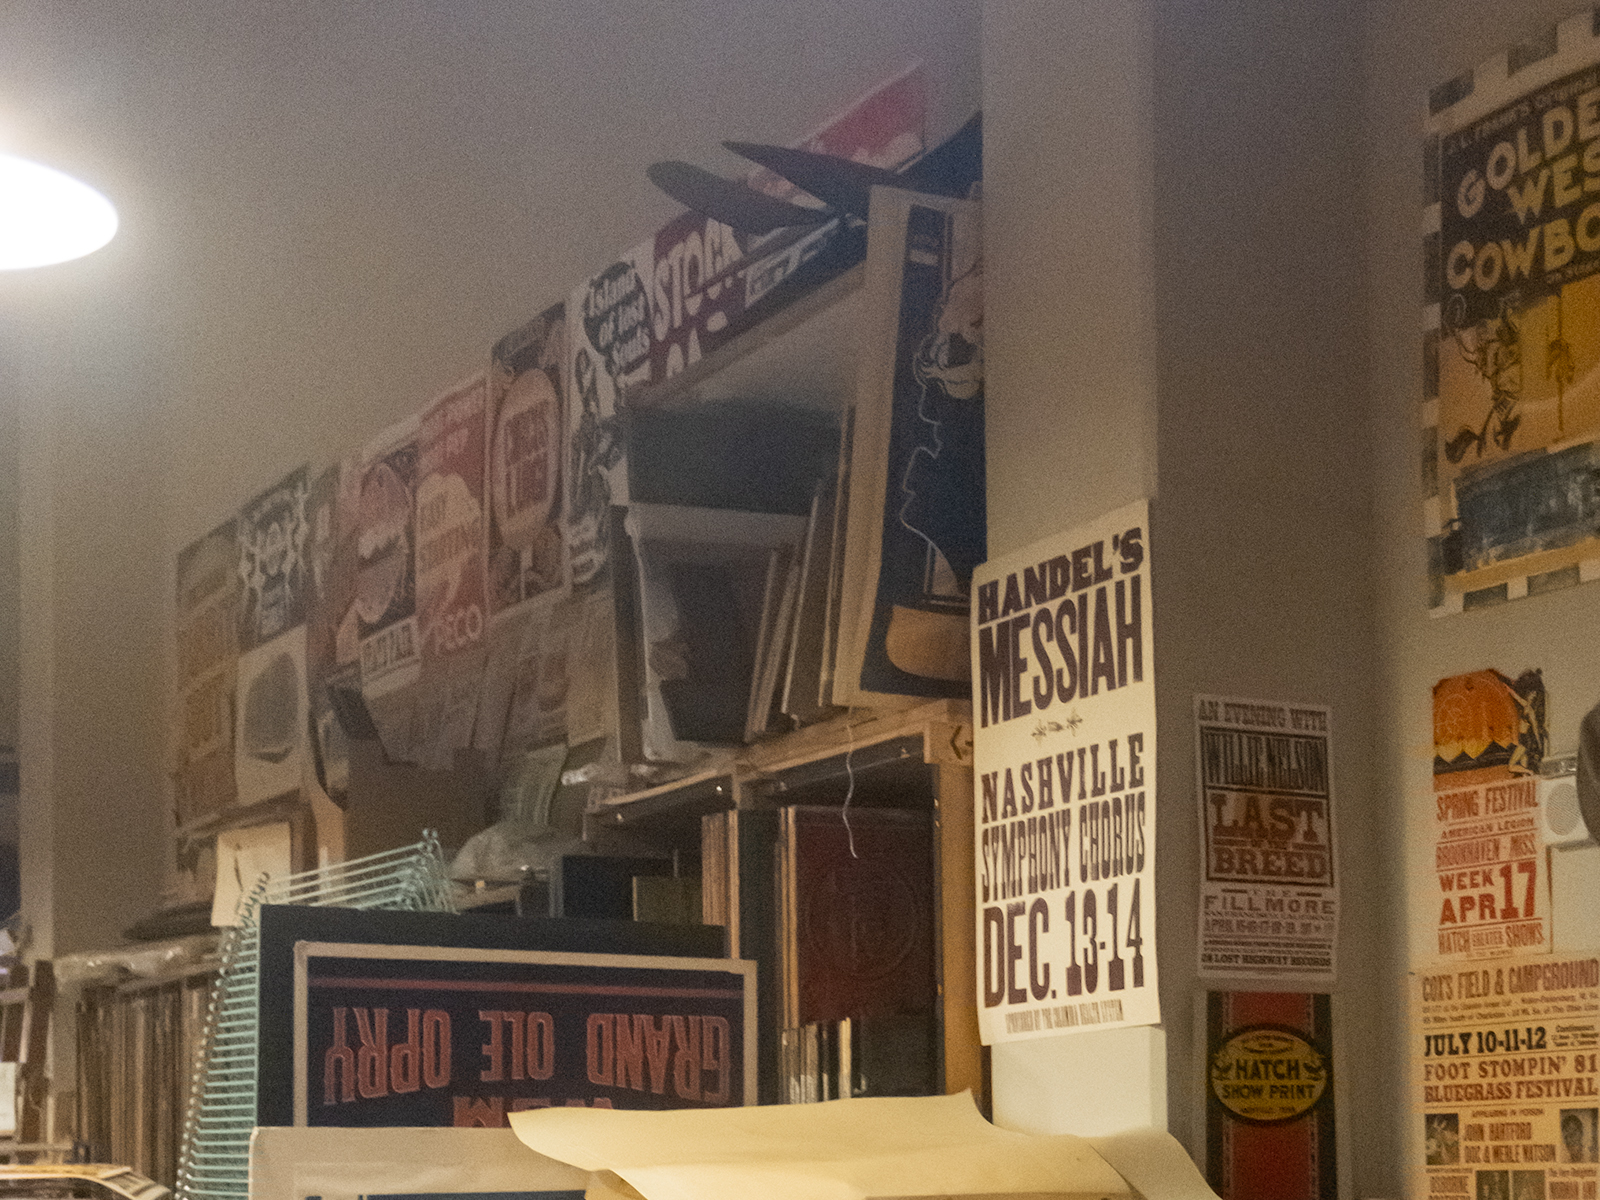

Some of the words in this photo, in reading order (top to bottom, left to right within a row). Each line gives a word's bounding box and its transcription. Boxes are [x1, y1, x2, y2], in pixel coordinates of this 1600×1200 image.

[978, 527, 1144, 625] HANDEL'S
[980, 574, 1143, 728] MESSIAH
[981, 732, 1144, 823] NASHVILLE
[1211, 793, 1323, 842] LAST
[1436, 790, 1479, 822] SPRING
[1485, 781, 1539, 815] FESTIVAL
[981, 808, 1072, 902] SYMPHONY
[1080, 791, 1145, 883] CHORUS
[1441, 822, 1494, 840] AMERICAN
[1497, 816, 1535, 832] LEGION
[1213, 846, 1327, 878] BREED
[1438, 868, 1495, 893] WEEK
[1204, 895, 1335, 914] FILLMORE
[1439, 893, 1497, 925] APR
[1499, 860, 1537, 920] 17
[983, 897, 1057, 1008] DEC.
[1064, 878, 1145, 998] 13-14
[1438, 929, 1471, 955] HATCH
[1422, 974, 1453, 1002] COX'S
[1458, 969, 1490, 999] FIELD
[1494, 968, 1504, 995] &
[1509, 958, 1600, 994] CAMPGROUND
[324, 1006, 453, 1106] OPRY
[480, 1009, 556, 1082] OLE
[586, 1013, 732, 1104] GRAND
[1424, 1032, 1473, 1057] JULY
[1476, 1026, 1547, 1053] 10-11-12
[1235, 1059, 1300, 1080] HATCH
[1424, 1061, 1471, 1081] FOOT
[1478, 1056, 1567, 1079] STOMPIN'
[1574, 1054, 1598, 1074] 81
[1222, 1084, 1264, 1099] SHOW
[1269, 1084, 1316, 1099] PRINT
[1424, 1081, 1513, 1103] BLUEGRASS
[1515, 1077, 1598, 1100] FESTIVAL
